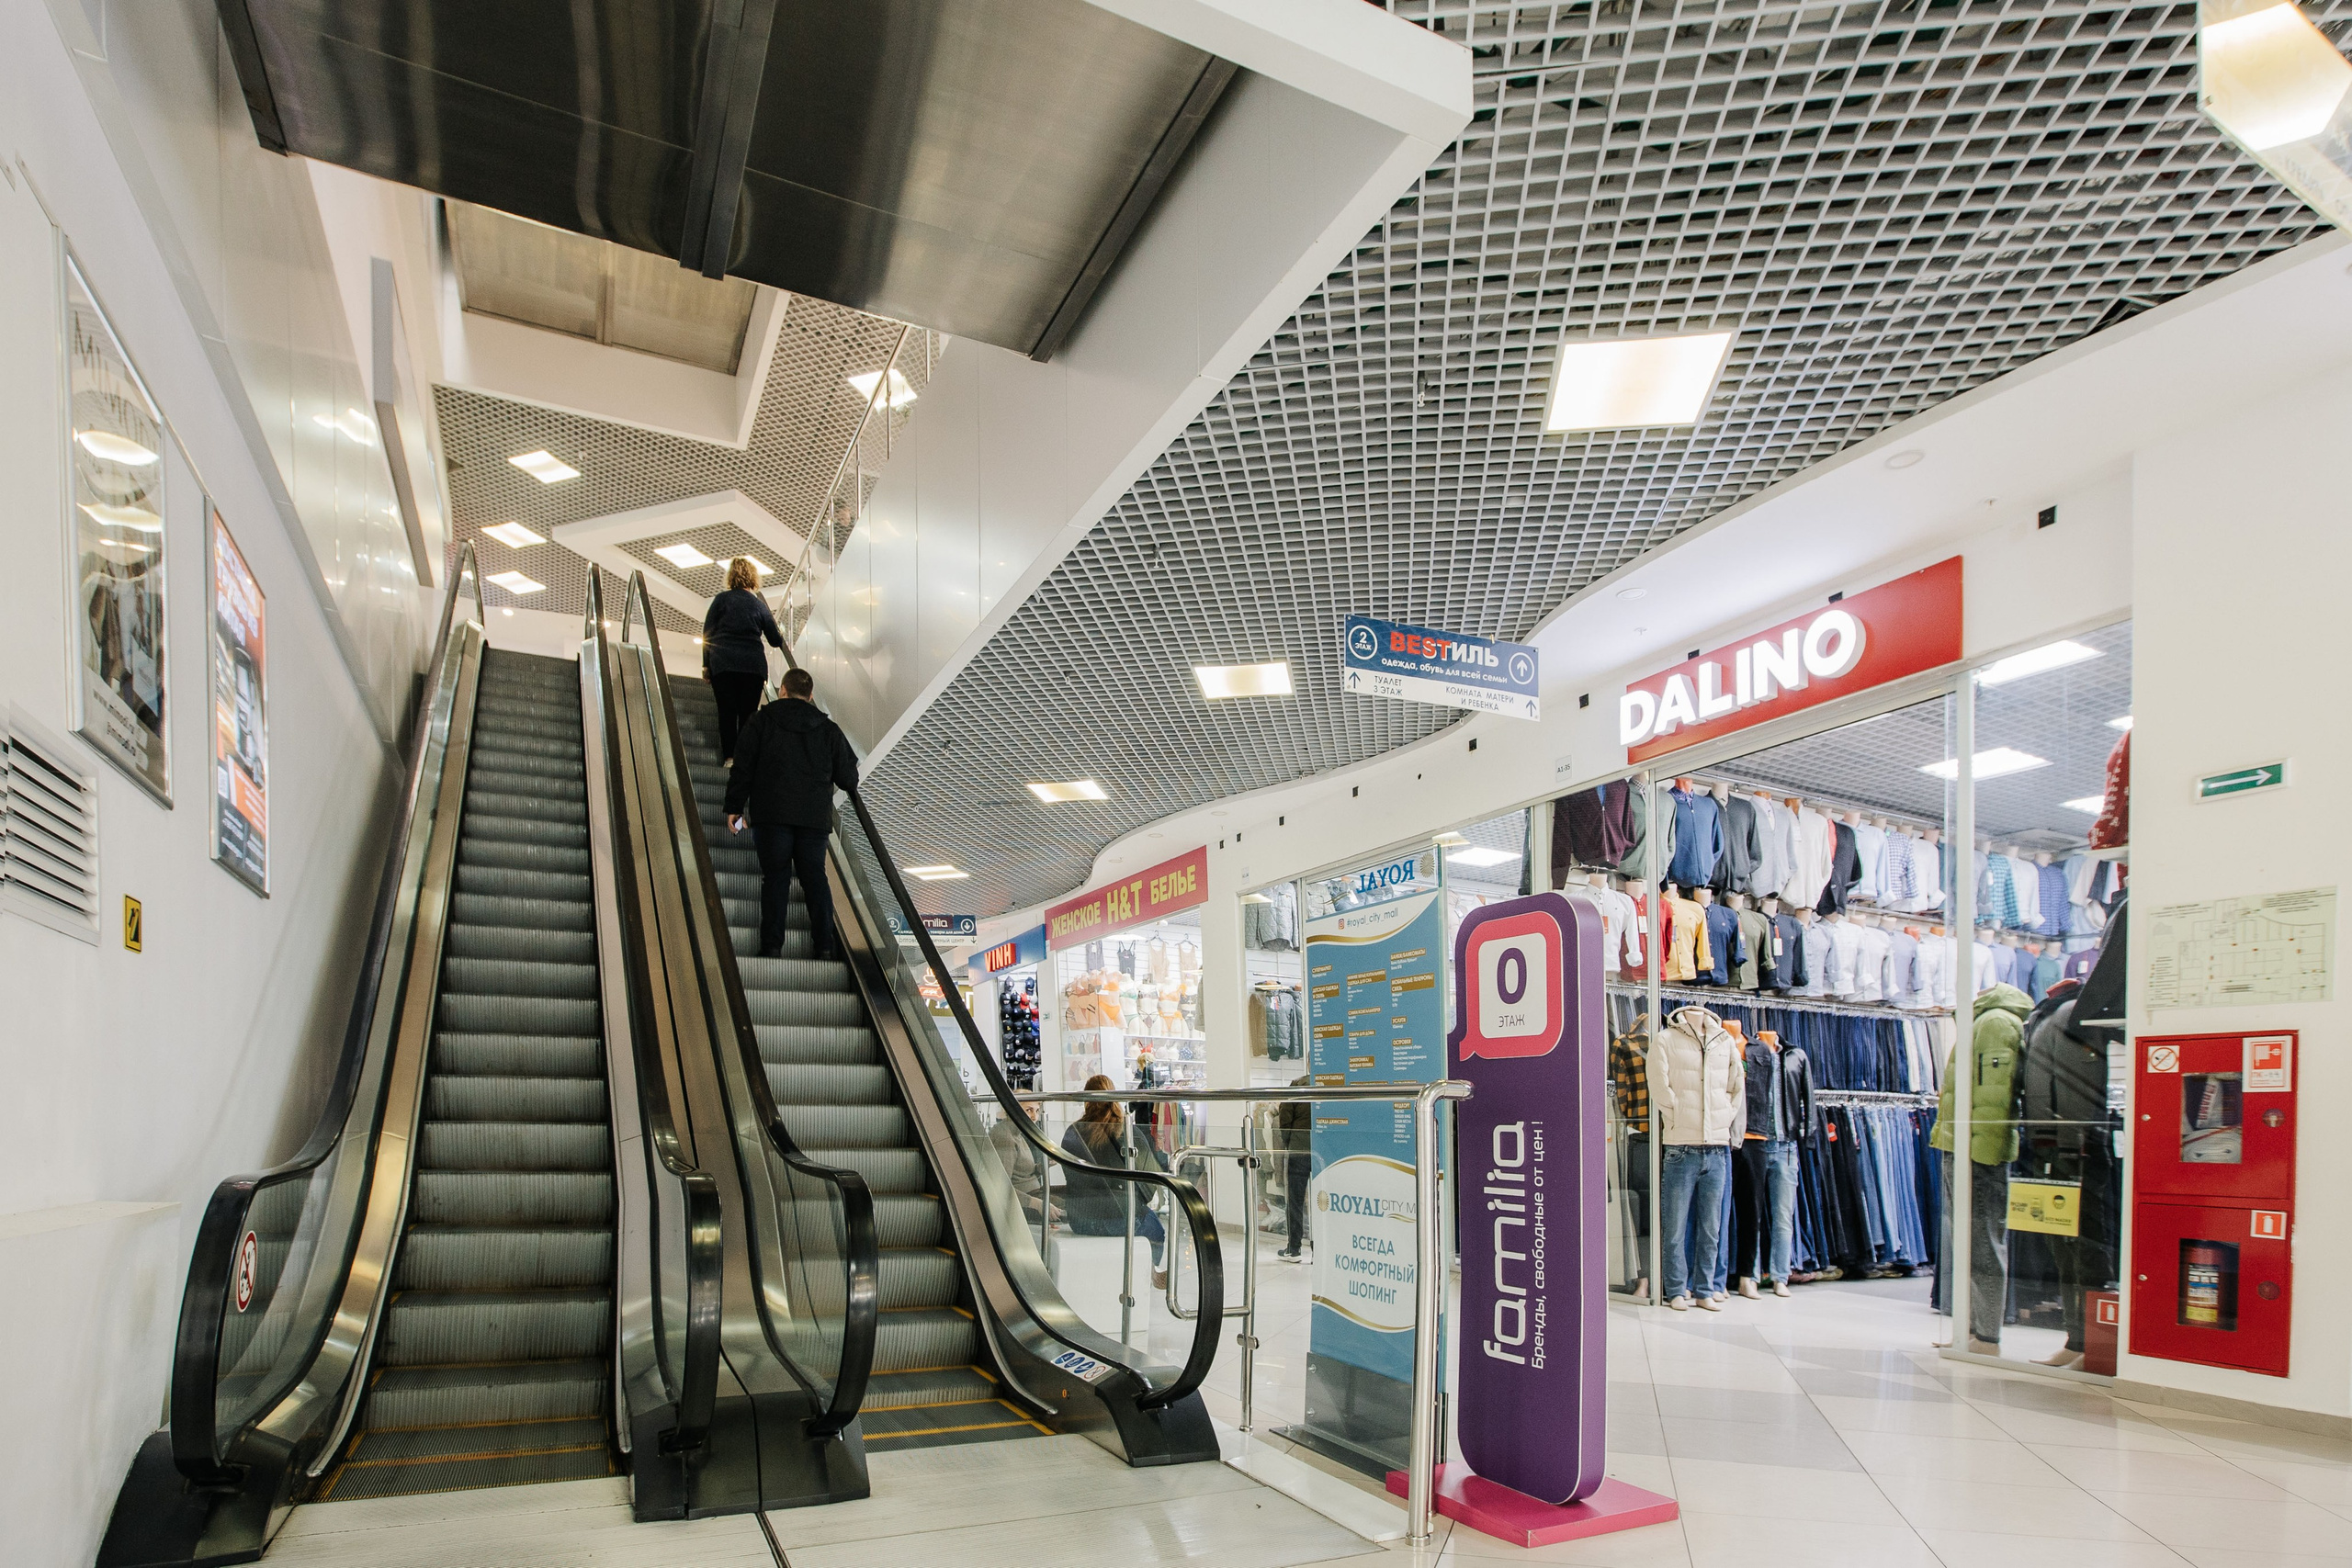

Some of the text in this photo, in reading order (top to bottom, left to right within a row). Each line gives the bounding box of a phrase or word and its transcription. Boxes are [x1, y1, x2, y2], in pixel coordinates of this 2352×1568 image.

[1355, 643, 1372, 651] ЭТАЖ
[1360, 631, 1367, 643] 2
[1390, 631, 1498, 667] BESTИЛЬ
[1374, 675, 1402, 686] ТУАЛЕТ
[1381, 658, 1508, 683] одежда, обувь для всей семьи
[1620, 609, 1866, 747] DALINO
[1381, 686, 1403, 696] ЭТАЖ
[1445, 686, 1514, 704] КОМНАТА МАТЕРИ
[1468, 699, 1499, 711] РЕБЕНКА
[1051, 864, 1197, 939] ЖЕНСКОЕ H&T БЕЛЬЕ
[922, 918, 948, 928] milia
[1346, 907, 1398, 928] #royal_city_mall
[984, 942, 1014, 972] VINH
[1497, 947, 1527, 1005] 0
[1498, 1014, 1525, 1028] ЭТАЖ
[1533, 1133, 1545, 1162] цен
[1533, 1167, 1544, 1187] от
[1329, 1192, 1385, 1218] ROYAL
[1381, 1199, 1404, 1213] CITY
[1352, 1235, 1395, 1256] ВСЕГДА
[1484, 1121, 1526, 1365] familia
[1532, 1192, 1545, 1289] свободные
[1335, 1254, 1415, 1284] КОМФОРТНЫЙ
[1349, 1280, 1397, 1304] ШОПИНГ
[1532, 1295, 1546, 1369] Бренды,
